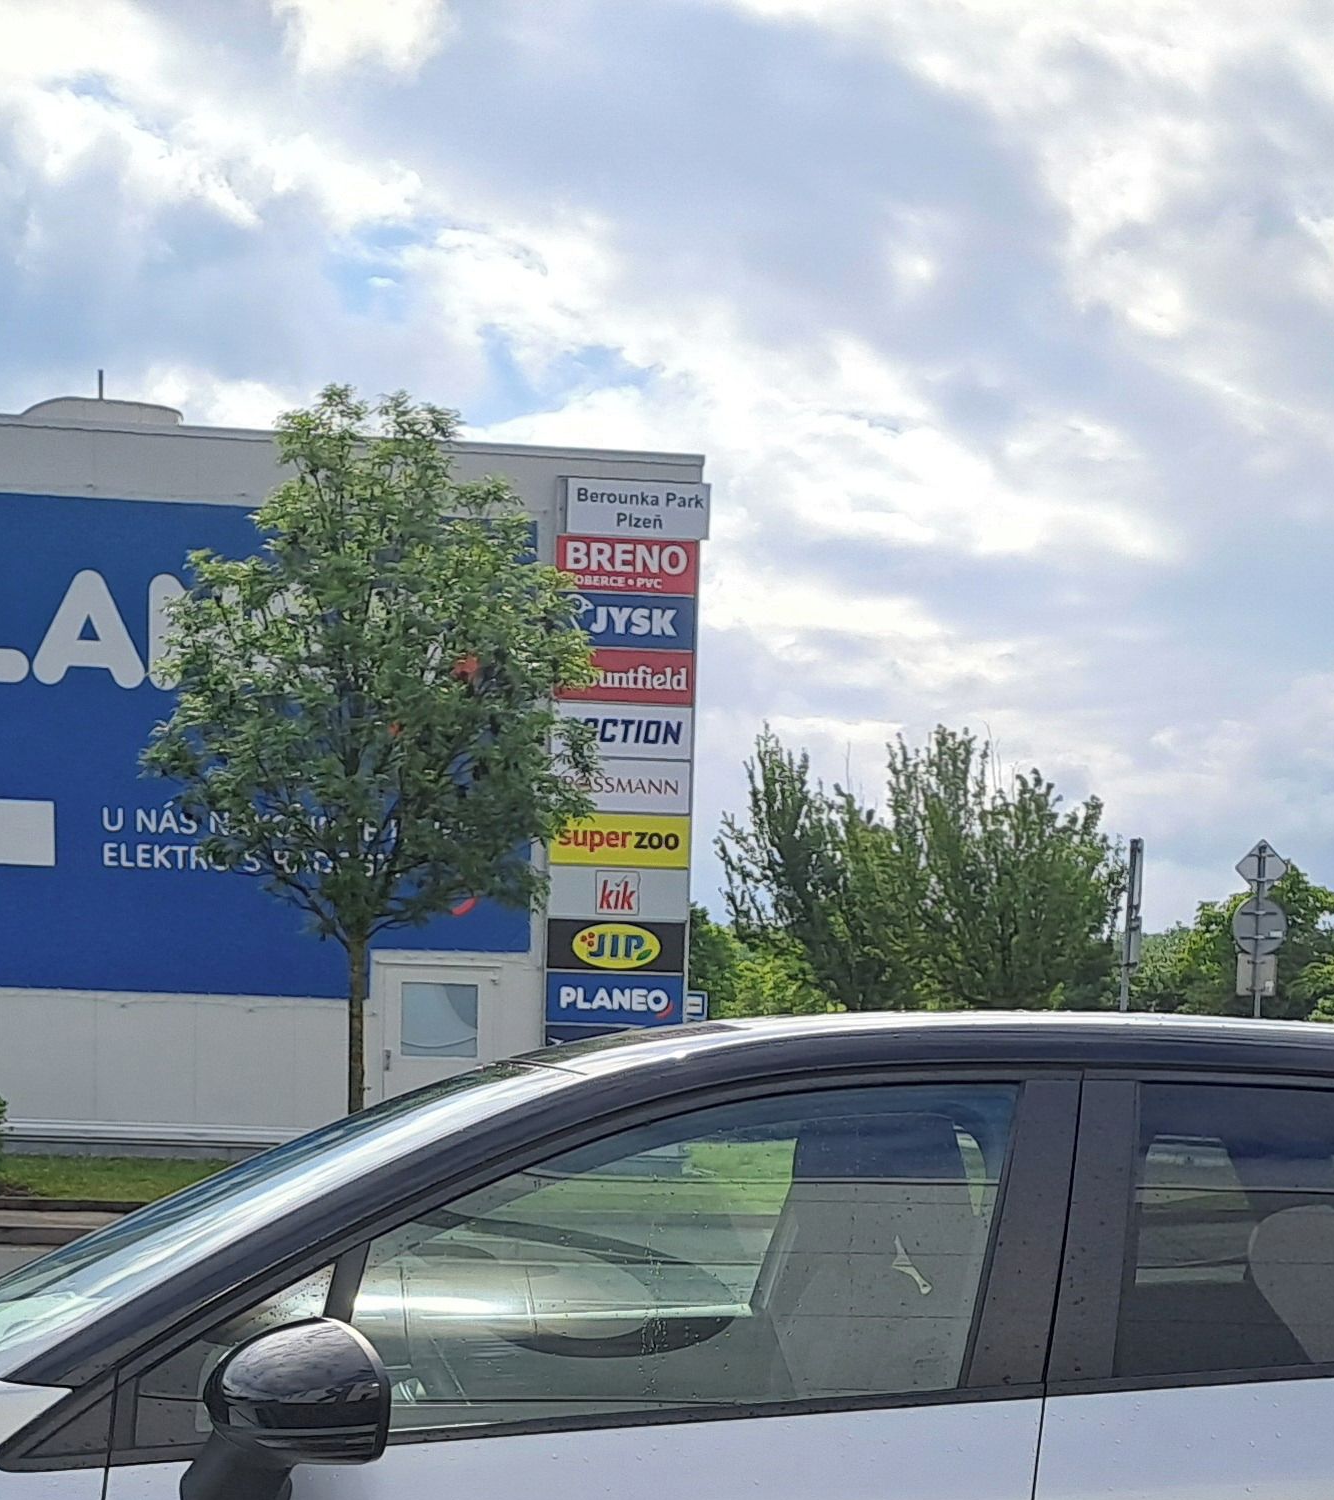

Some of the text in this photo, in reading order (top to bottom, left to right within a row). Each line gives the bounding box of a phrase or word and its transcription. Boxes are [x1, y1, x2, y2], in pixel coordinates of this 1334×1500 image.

[577, 487, 704, 509] Berounka Park
[616, 512, 663, 530] Plzeň
[566, 541, 687, 575] BRENO
[575, 575, 663, 589] OBERCE PVC
[590, 606, 678, 637] JYSK
[586, 665, 687, 691] untfield
[102, 806, 124, 832] U
[136, 800, 198, 835] NÁS
[589, 933, 644, 958] JIP
[559, 985, 669, 1013] PLANEO
